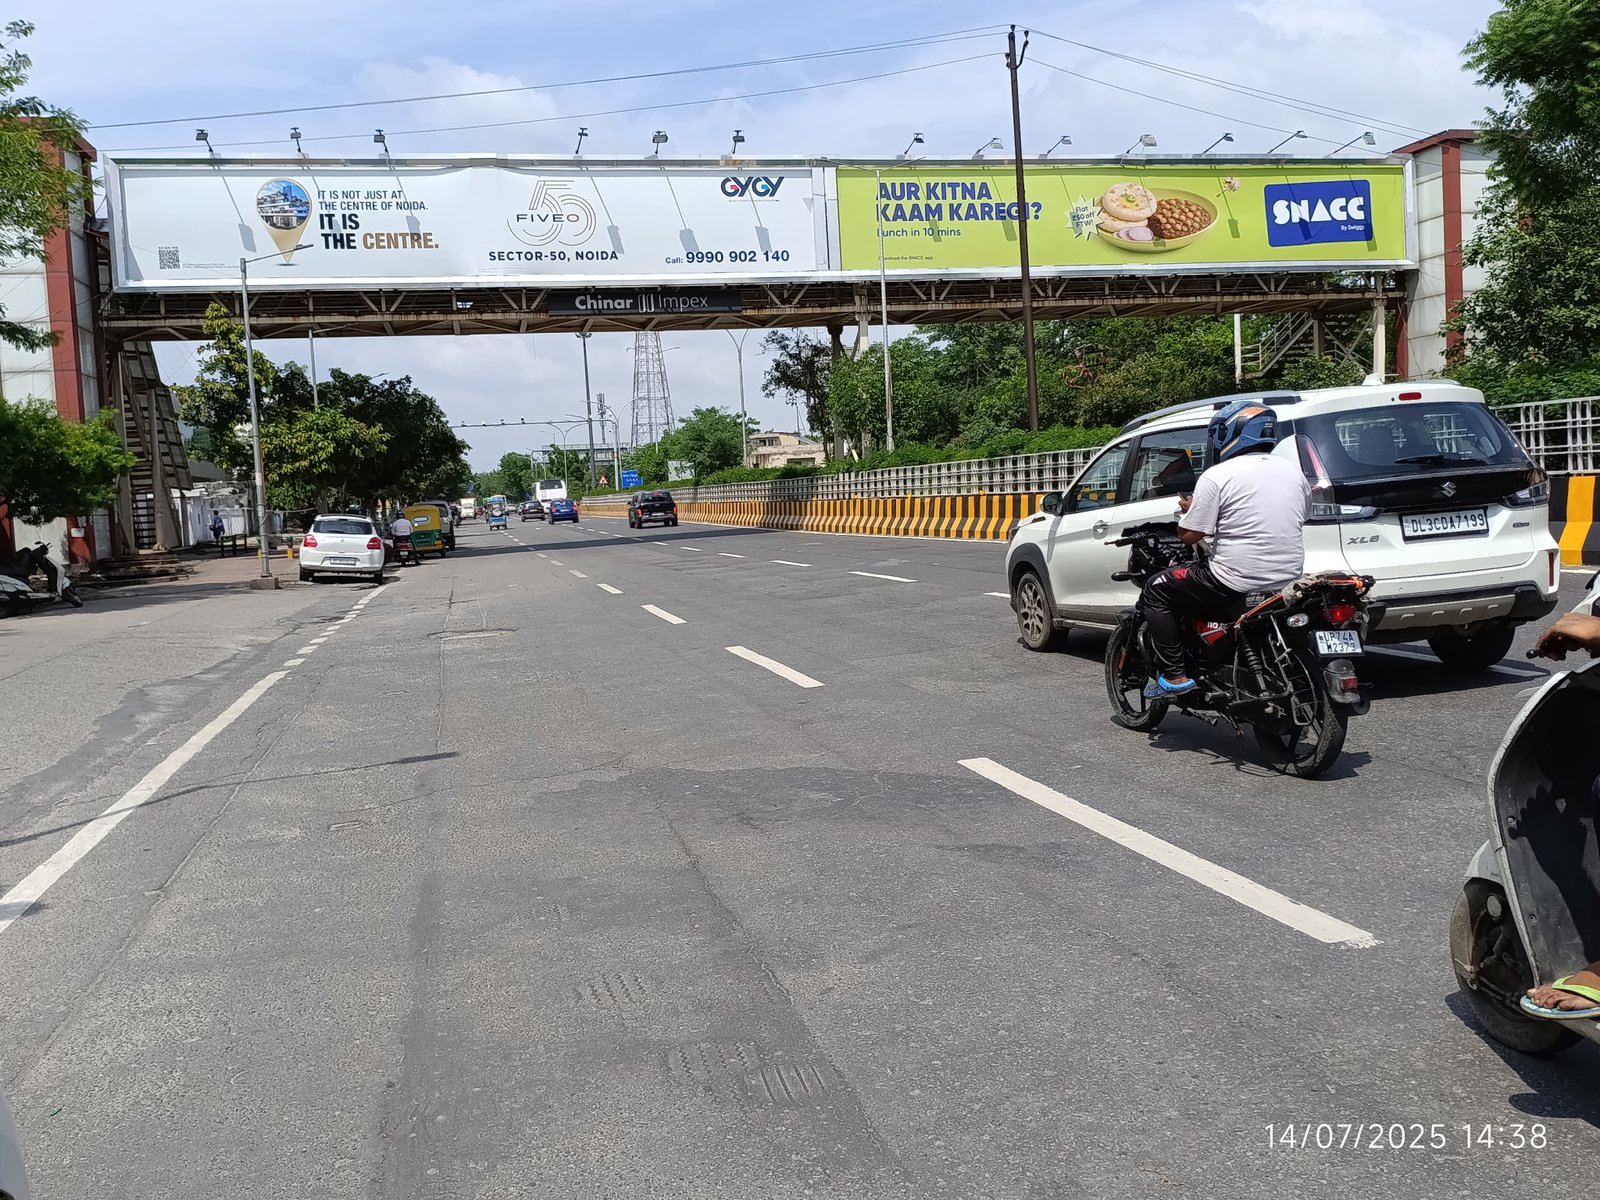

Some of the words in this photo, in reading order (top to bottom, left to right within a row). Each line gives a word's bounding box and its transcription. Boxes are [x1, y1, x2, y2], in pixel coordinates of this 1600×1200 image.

[318, 190, 326, 199] IT
[330, 190, 339, 199] IS
[342, 190, 360, 199] NOT
[364, 190, 388, 199] JUST
[391, 190, 403, 199] AT
[720, 176, 784, 197] GYGY
[876, 182, 920, 201] AUR
[926, 182, 992, 201] KITNA
[319, 201, 337, 210] THE
[340, 201, 378, 210] CENTRE
[381, 201, 392, 210] OF
[396, 201, 429, 210] NOIDA.
[877, 203, 943, 222] KAAM
[949, 202, 1043, 221] KAREGI?
[1075, 206, 1088, 214] Flat
[1273, 197, 1365, 225] SNACC
[319, 213, 336, 230] IT
[342, 213, 360, 230] IS
[516, 214, 580, 222] FIVEO
[911, 228, 920, 236] in
[923, 227, 935, 237] 10
[938, 227, 961, 236] mins
[321, 233, 357, 249] THE
[362, 233, 439, 249] CENTRE.
[488, 251, 571, 262] SECTOR-50,
[575, 251, 619, 260] NOIDA
[686, 251, 724, 263] 9990
[729, 251, 757, 262] 902
[763, 250, 790, 262] 140
[575, 295, 633, 310] Chinar
[659, 294, 709, 312] Impex
[1412, 513, 1485, 533] DL3CDA7199
